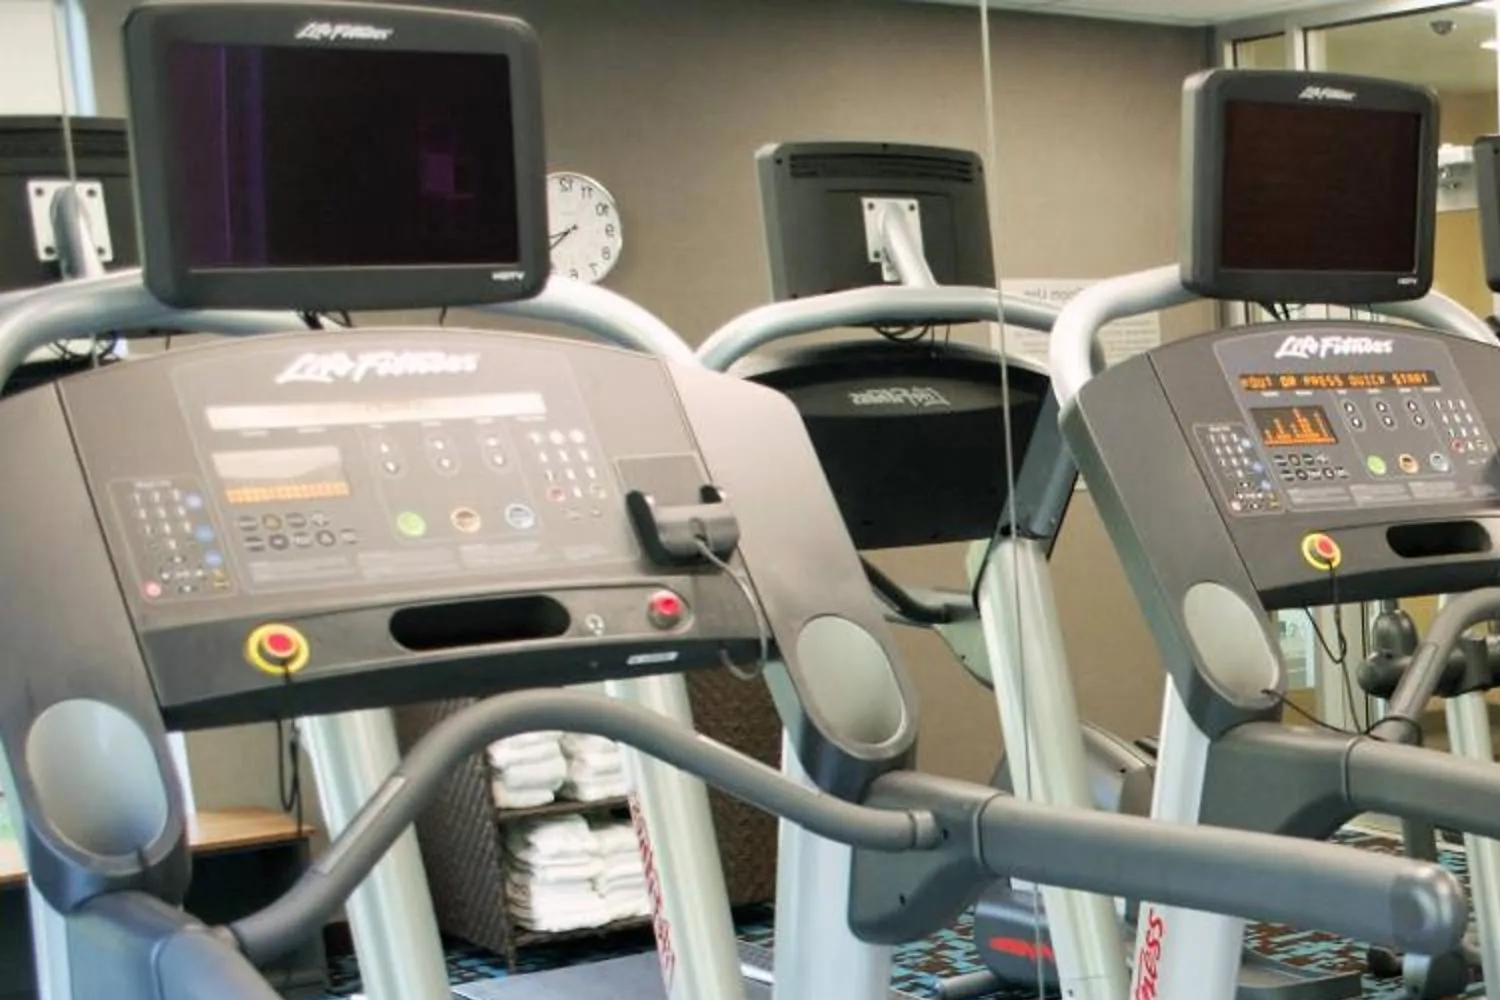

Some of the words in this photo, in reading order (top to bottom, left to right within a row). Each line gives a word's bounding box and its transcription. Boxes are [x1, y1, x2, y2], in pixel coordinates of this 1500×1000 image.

[1274, 335, 1319, 359] Life
[1319, 335, 1393, 359] Fitness
[275, 351, 354, 384] Life
[351, 350, 480, 383] Fitness
